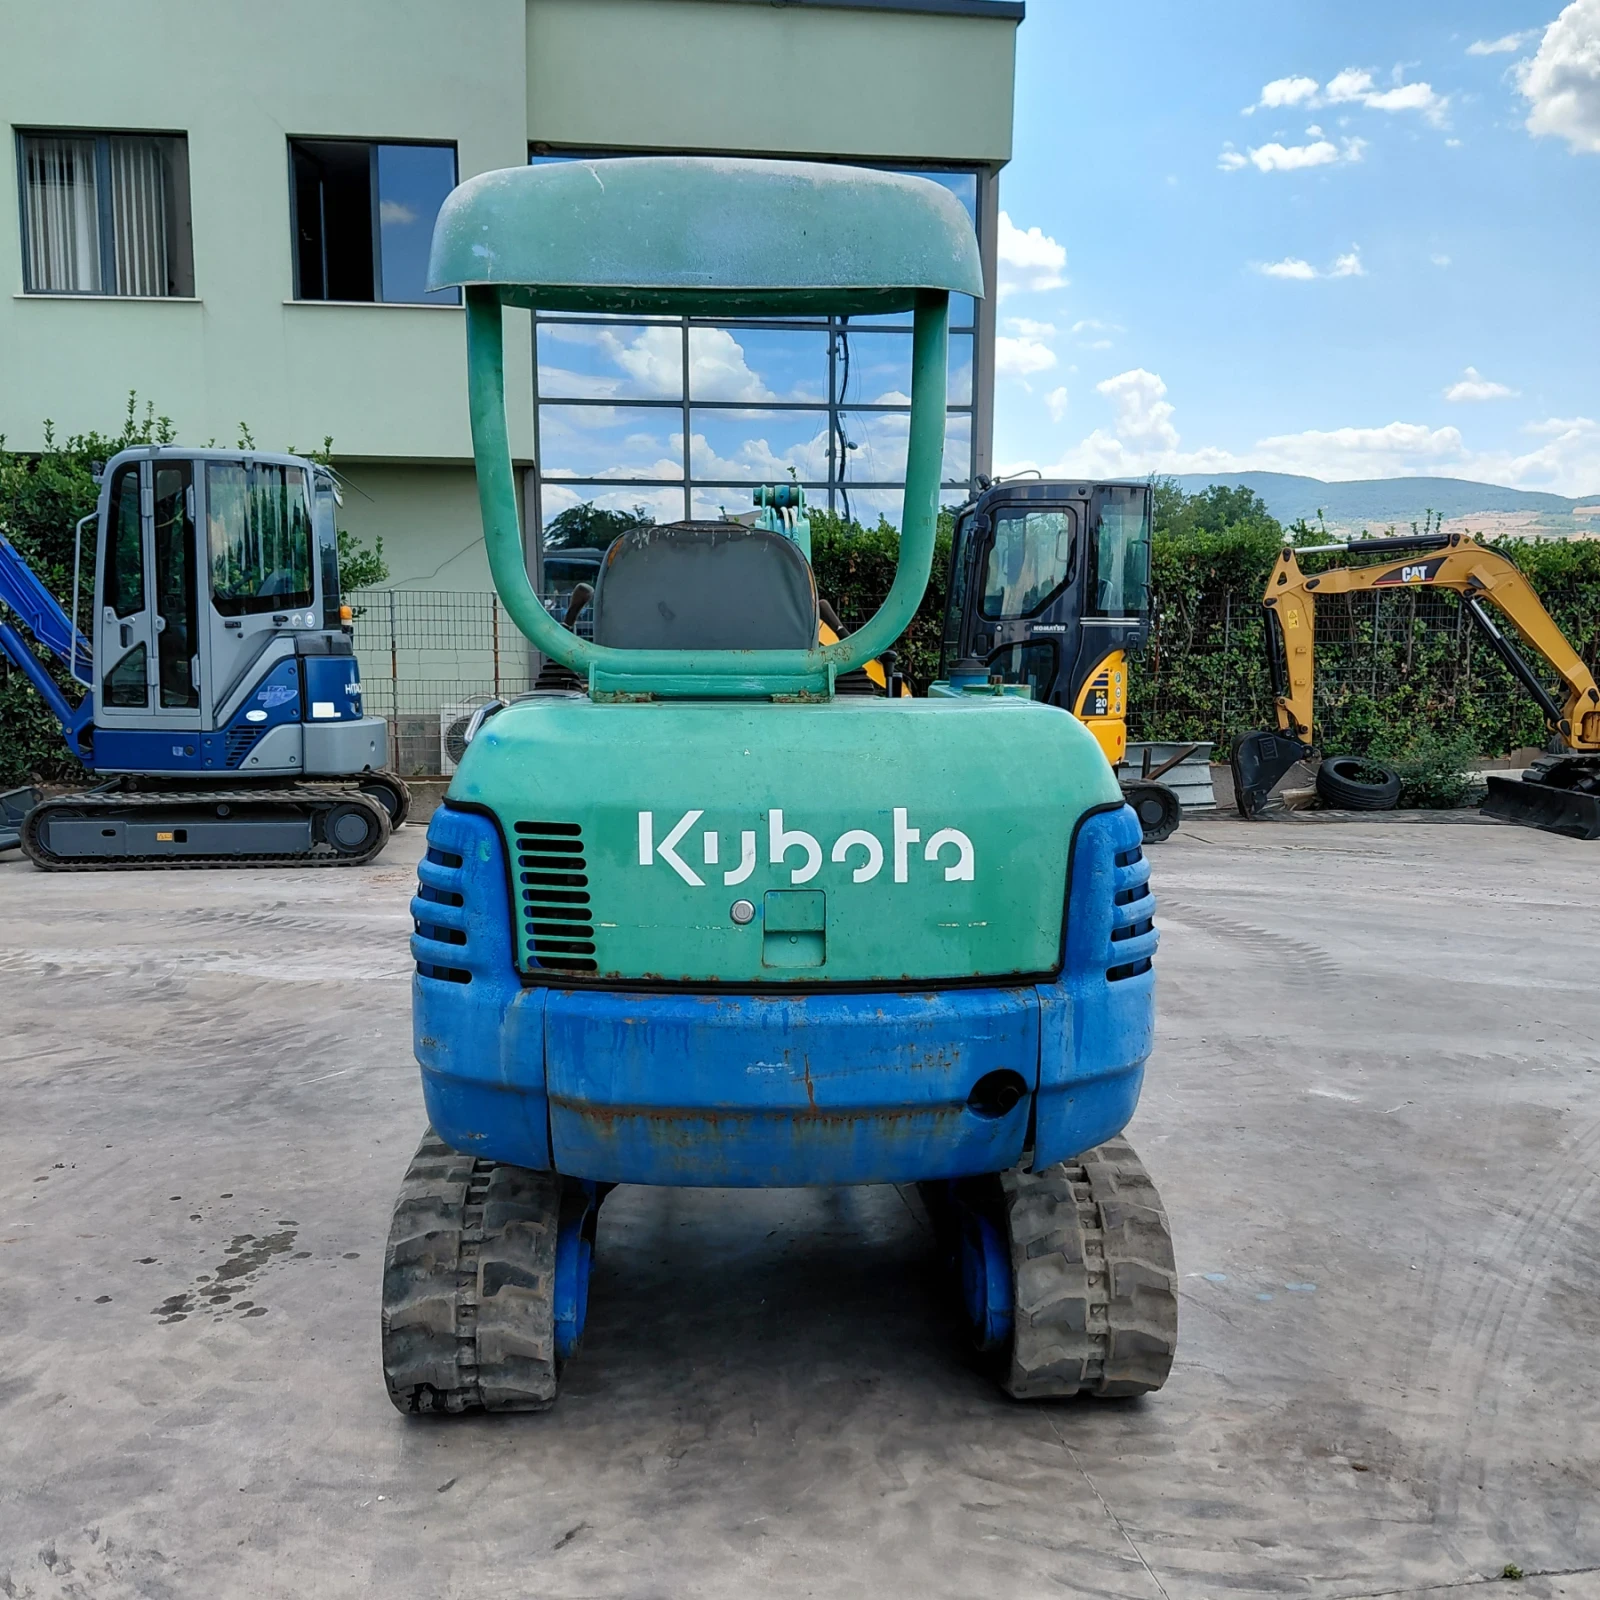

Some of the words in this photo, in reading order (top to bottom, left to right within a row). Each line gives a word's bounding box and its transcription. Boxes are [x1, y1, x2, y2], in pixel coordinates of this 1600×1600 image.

[1401, 565, 1428, 582] CAT
[1095, 690, 1105, 698] PC
[1095, 698, 1107, 708] 20
[638, 807, 975, 887] Kubota
